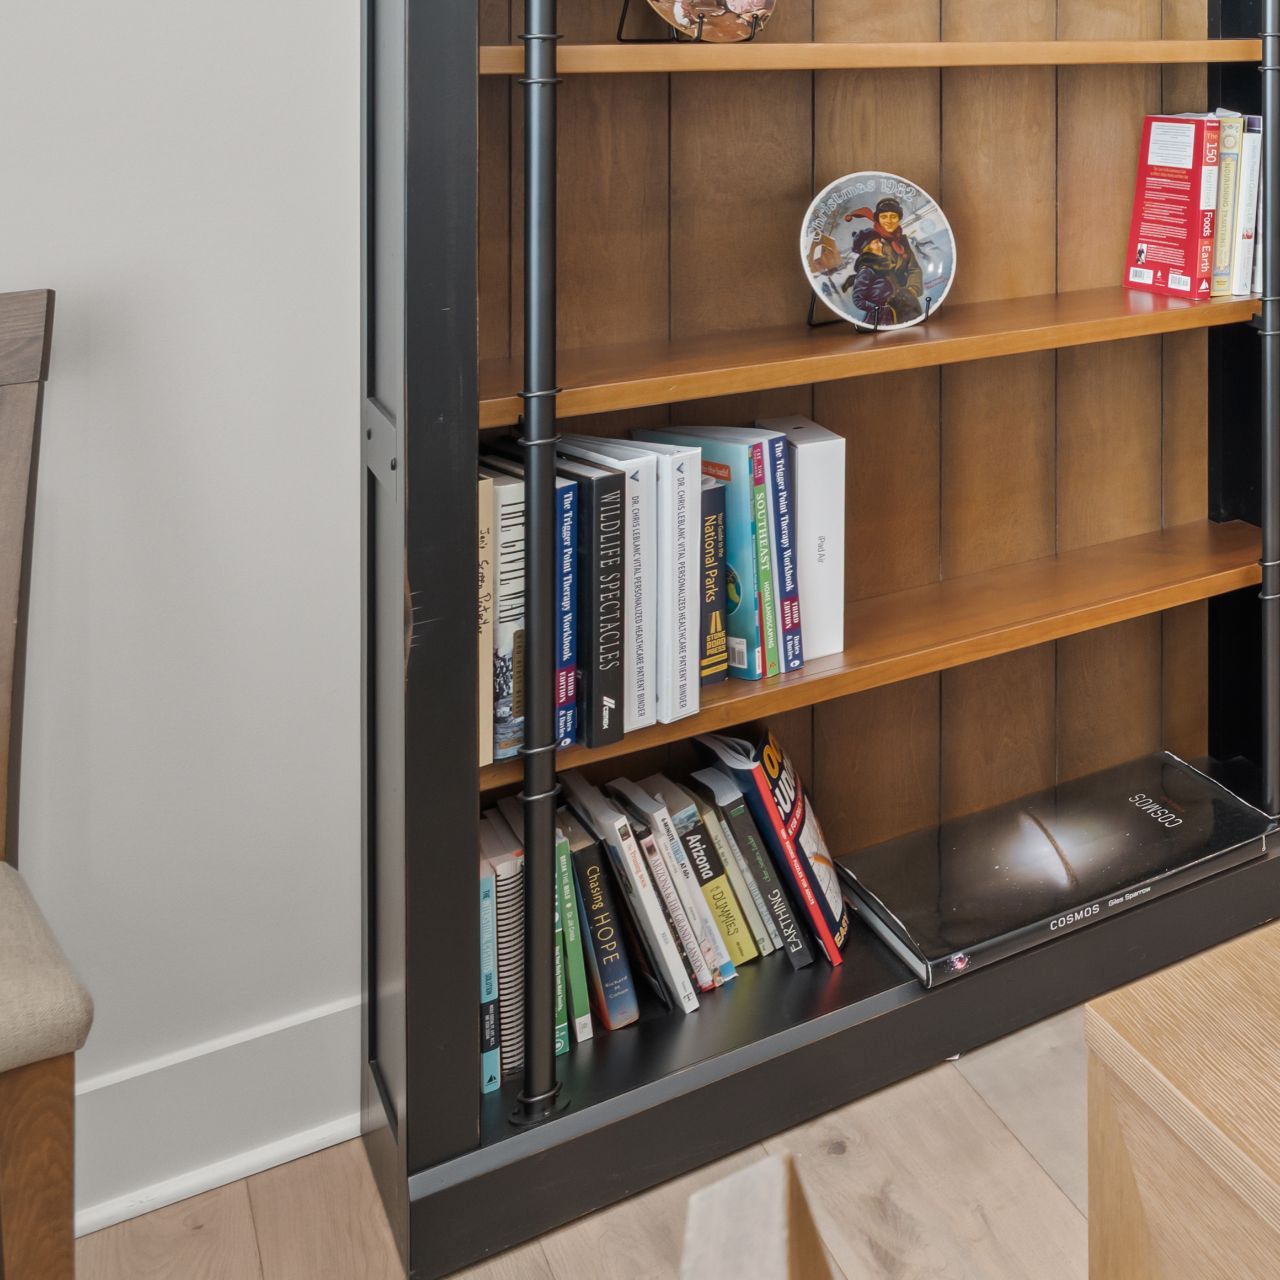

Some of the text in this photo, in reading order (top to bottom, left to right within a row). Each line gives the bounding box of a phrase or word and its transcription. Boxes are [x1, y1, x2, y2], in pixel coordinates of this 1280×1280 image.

[1206, 142, 1217, 163] 150
[1222, 162, 1230, 206] NOURISHING
[1203, 212, 1212, 237] Foods
[1201, 245, 1211, 272] Earth
[501, 500, 524, 532] THE
[755, 492, 769, 571] SOUTHEAST
[774, 441, 794, 591] The Trigger Point Therapy Workbook
[500, 538, 524, 586] CIVIL
[562, 492, 573, 661] The Trigger Point Therapy Workbook
[599, 490, 621, 670] WILDLIFE SPECTACLES
[704, 514, 717, 602] National Parks
[631, 495, 645, 716] DR. CHRIS LEBLANC VITAL PERSONALIZED HEALTHCARE PATIENT BINDER
[676, 477, 688, 707] DR. CHRIS LEBLANC VITAL PERSONALIZED HEALTHCARE PATIENT BINDER
[762, 581, 775, 648] HOME LANDSCAPING
[783, 601, 791, 628] EDITION
[707, 645, 726, 656] PRESS
[786, 640, 794, 659] Davies
[661, 817, 674, 841] 6-MINUTE
[1128, 793, 1183, 828] COSMOS
[687, 835, 712, 878] Arizona
[482, 889, 490, 899] THE
[587, 866, 619, 963] Chasing HOPE
[651, 857, 671, 892] ARIZONA
[667, 899, 679, 912] THE
[673, 913, 689, 941] GRAND
[685, 941, 702, 973] CANYON
[712, 891, 737, 935] DUMMIES
[805, 888, 814, 904] ADULTS
[1049, 886, 1152, 931] COSMOS Giles Sparrow
[768, 888, 802, 953] EARTHING
